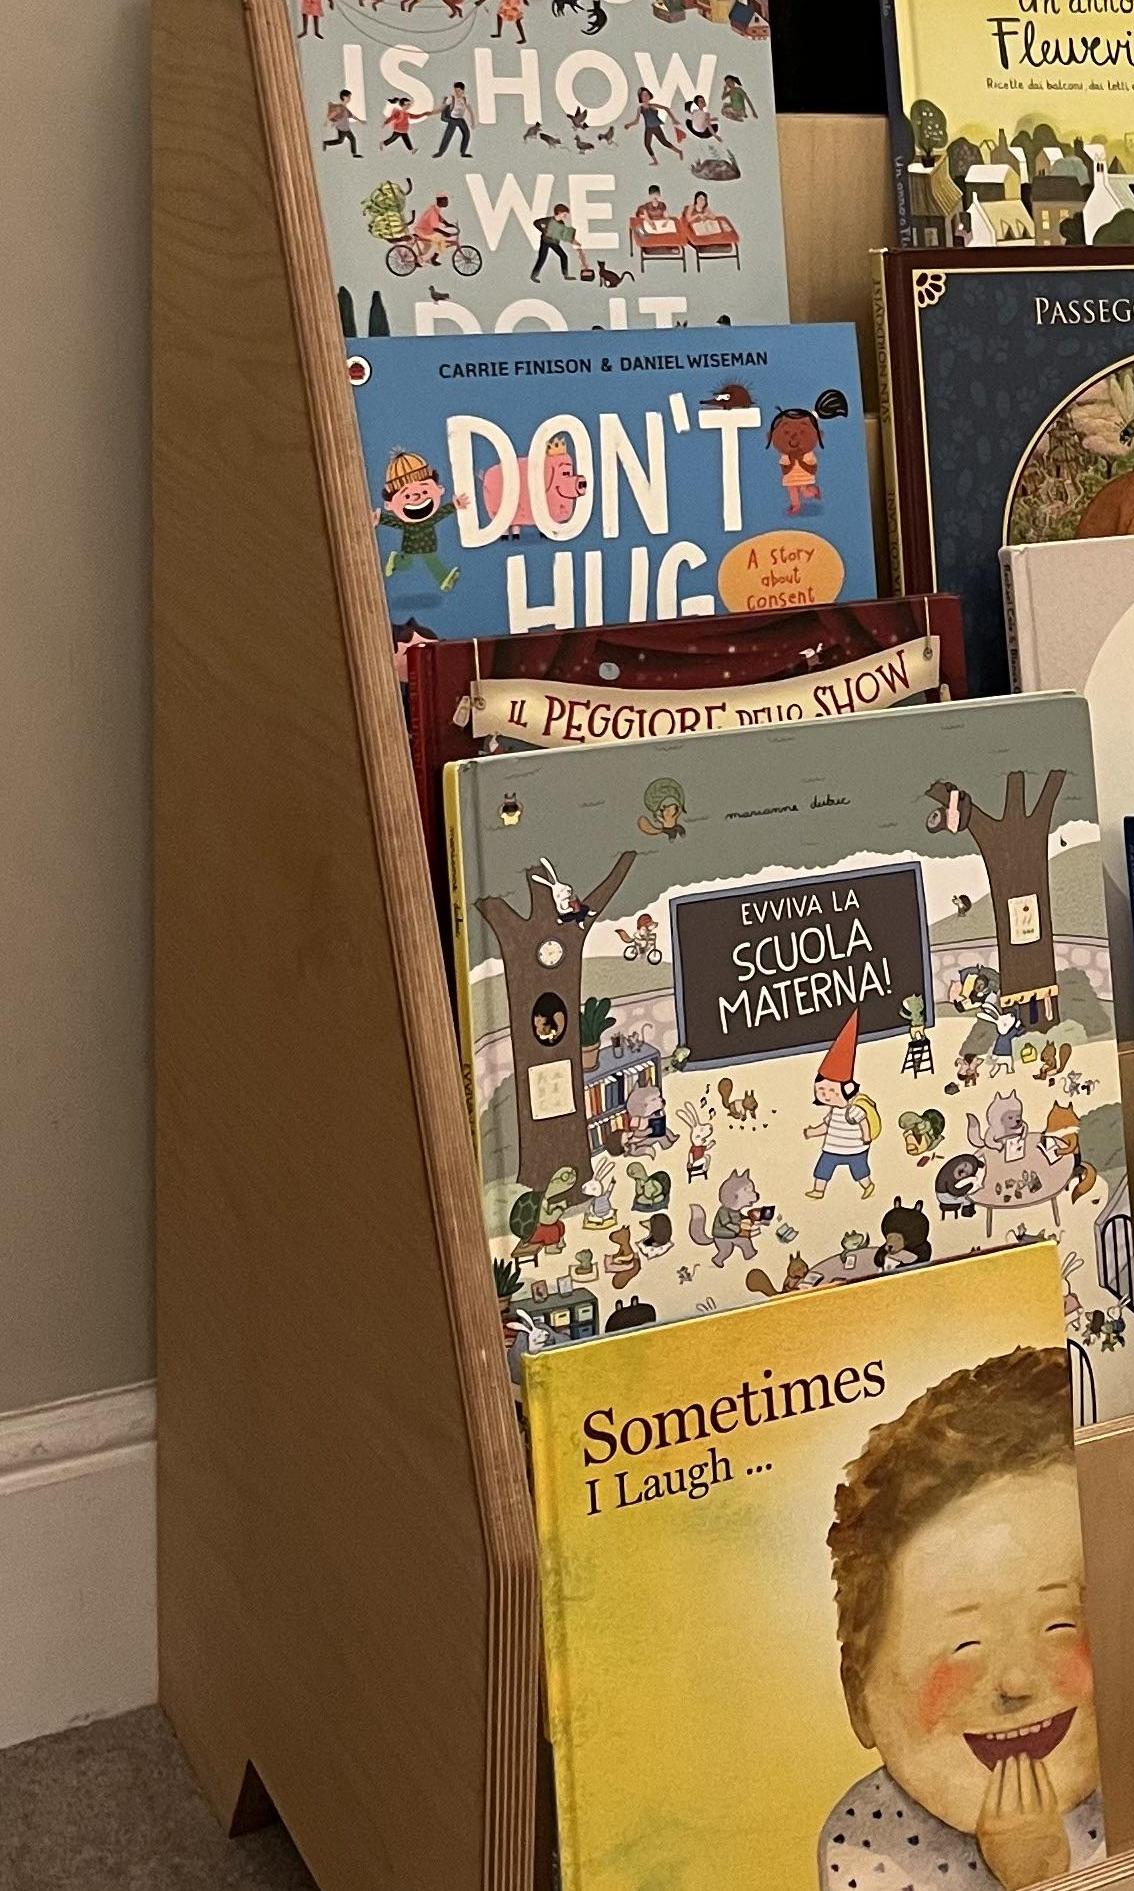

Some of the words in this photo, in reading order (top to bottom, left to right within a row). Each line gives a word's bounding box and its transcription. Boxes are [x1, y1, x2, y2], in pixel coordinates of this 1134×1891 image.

[342, 43, 435, 126] IS
[473, 47, 718, 127] HOW
[465, 172, 620, 253] WE
[438, 360, 509, 380] CARRIE
[514, 357, 592, 377] FINISON
[600, 357, 613, 373] &
[620, 353, 685, 373] DANIEL
[687, 350, 769, 371] WISEMAN
[446, 392, 762, 549] DON'T
[505, 540, 716, 636] HUG
[746, 548, 760, 568] A
[760, 566, 802, 588] about
[507, 700, 528, 728] IL
[541, 693, 728, 744] PEGGIORE
[812, 649, 912, 718] SHOW
[725, 804, 799, 820] marianne
[810, 793, 851, 810] dubuc
[741, 894, 823, 926] EVVIVA
[831, 887, 861, 913] LA
[732, 918, 873, 983] SCUOLA
[717, 956, 894, 1036] MATERNA!
[581, 1357, 887, 1469] Sometimes
[584, 1479, 604, 1516] I
[614, 1448, 734, 1512] Laugh
